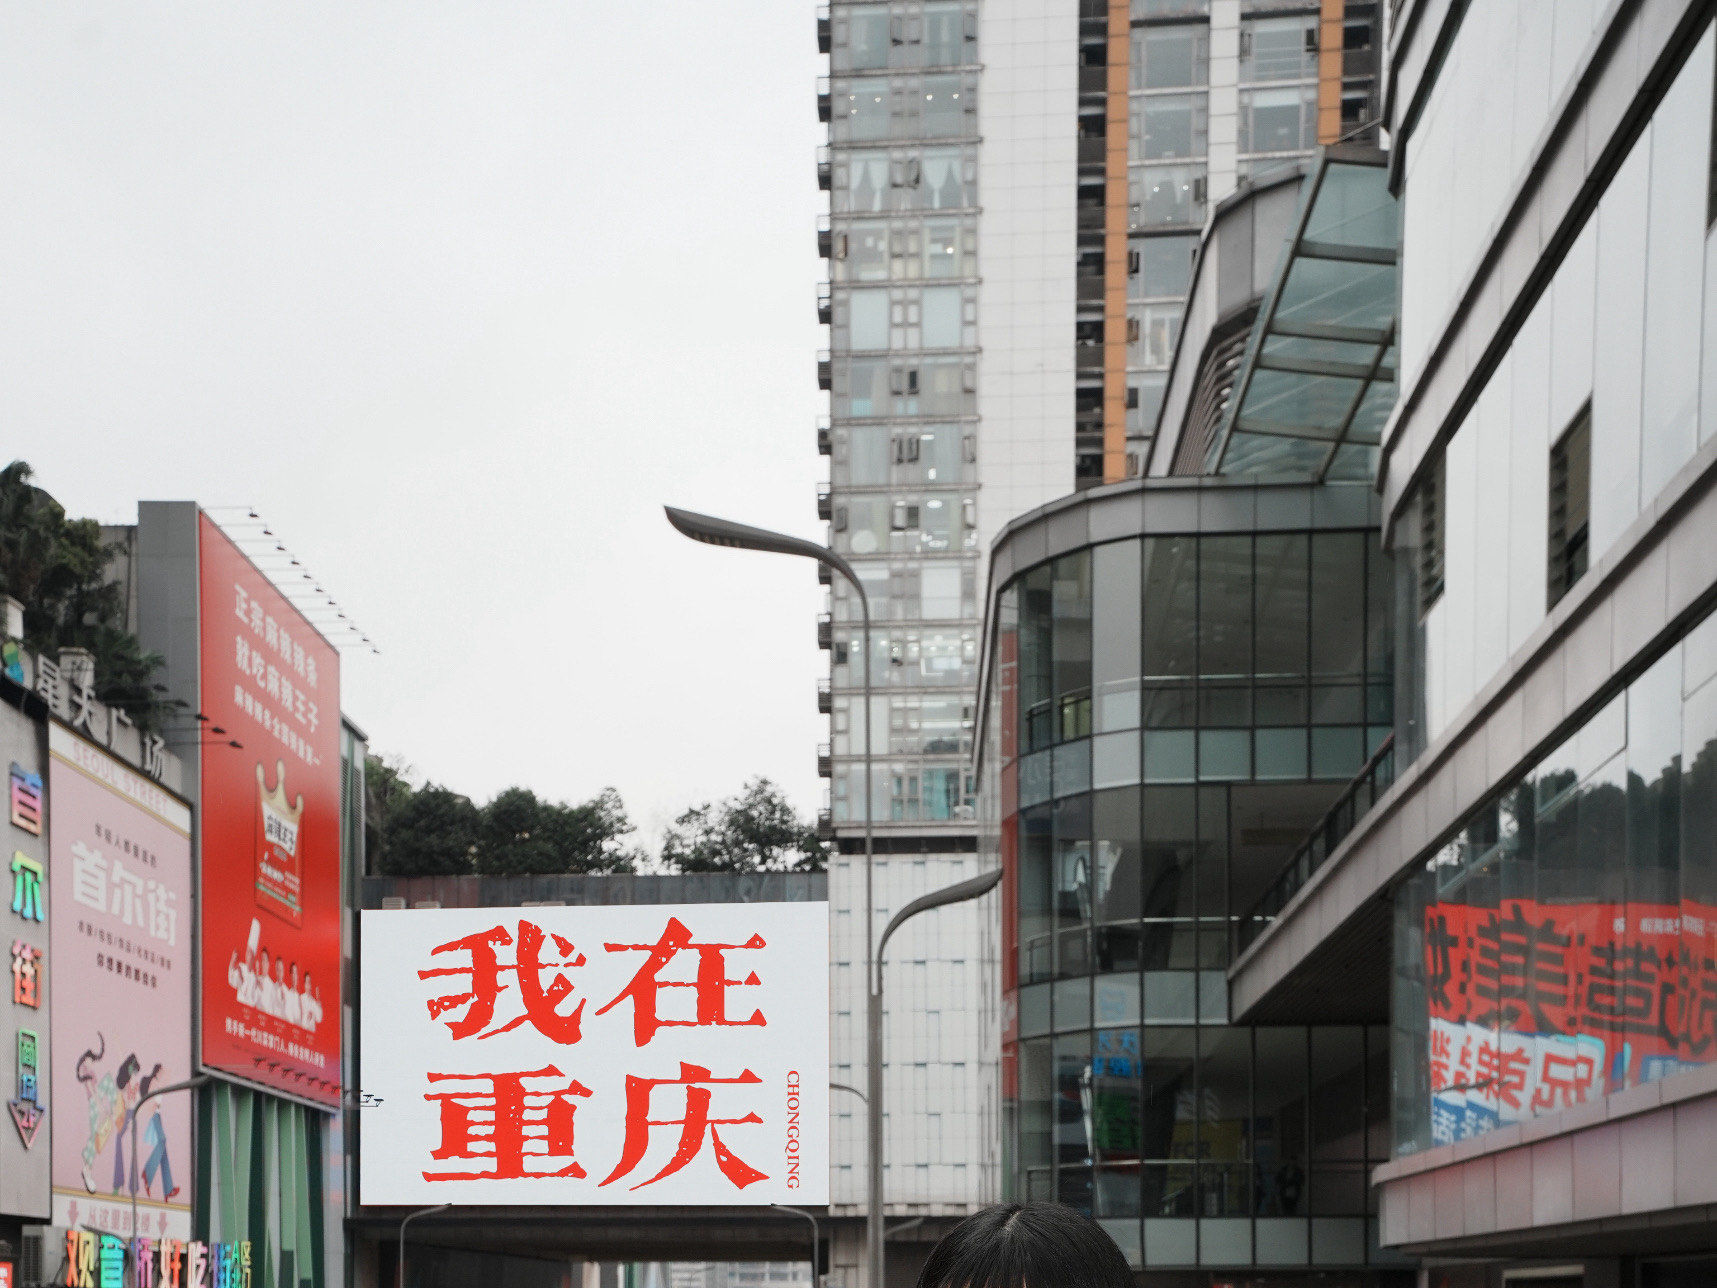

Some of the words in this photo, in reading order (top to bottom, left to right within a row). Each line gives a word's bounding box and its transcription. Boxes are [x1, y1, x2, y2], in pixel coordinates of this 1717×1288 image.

[235, 635, 319, 733] 就吃麻辣王子
[70, 840, 177, 947] 首尔街
[417, 916, 767, 1047] 我在
[421, 1061, 770, 1190] 重庆
[786, 1070, 800, 1190] CHONGQING
